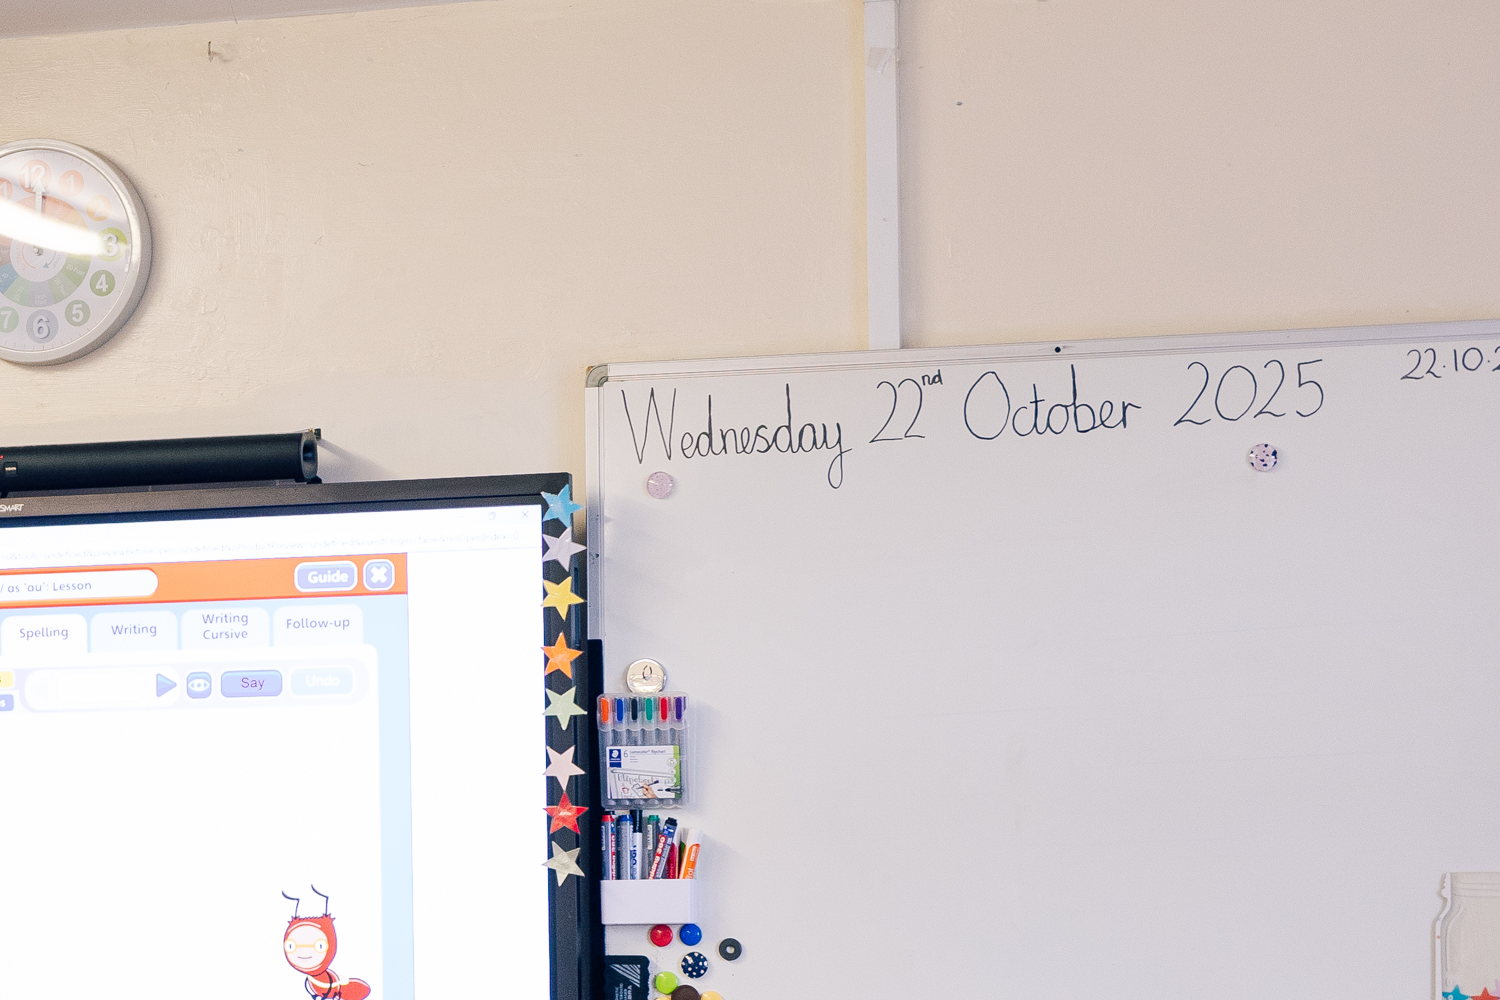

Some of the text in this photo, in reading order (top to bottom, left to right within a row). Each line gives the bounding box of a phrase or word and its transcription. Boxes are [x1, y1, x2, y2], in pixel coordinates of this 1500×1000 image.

[22, 164, 45, 189] 12
[93, 198, 105, 217] 2
[102, 232, 120, 257] 3
[95, 273, 108, 292] 4
[0, 303, 84, 339] 7 6 5
[621, 383, 852, 489] Wednesday
[964, 364, 1142, 440] October
[1174, 358, 1324, 426] 2025
[0, 503, 25, 512] SMART
[307, 569, 349, 584] Guide
[7, 585, 20, 593] as
[52, 581, 92, 592] Lesson
[19, 627, 69, 641] Spelling
[111, 623, 157, 637] Writing
[202, 613, 249, 626] Writing
[286, 617, 351, 630] Follow-up
[203, 628, 248, 640] Cursive
[241, 677, 265, 691] Say
[305, 674, 340, 687] Undo
